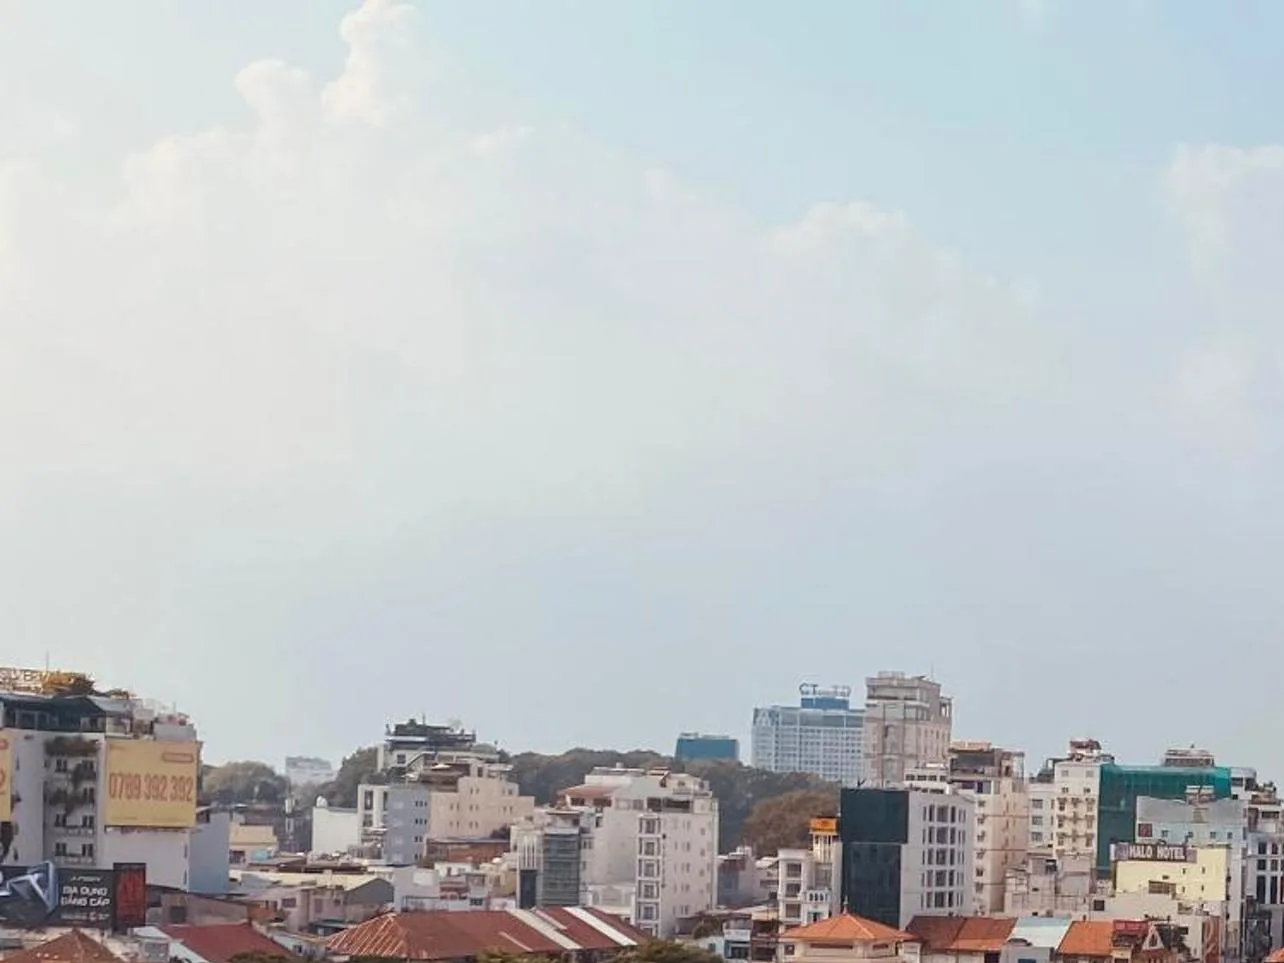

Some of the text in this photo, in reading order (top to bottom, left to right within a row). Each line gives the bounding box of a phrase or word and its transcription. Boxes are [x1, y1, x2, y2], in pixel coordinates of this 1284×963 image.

[144, 773, 167, 801] 392
[170, 775, 193, 802] 392
[1130, 845, 1186, 860] HALO HOTEL
